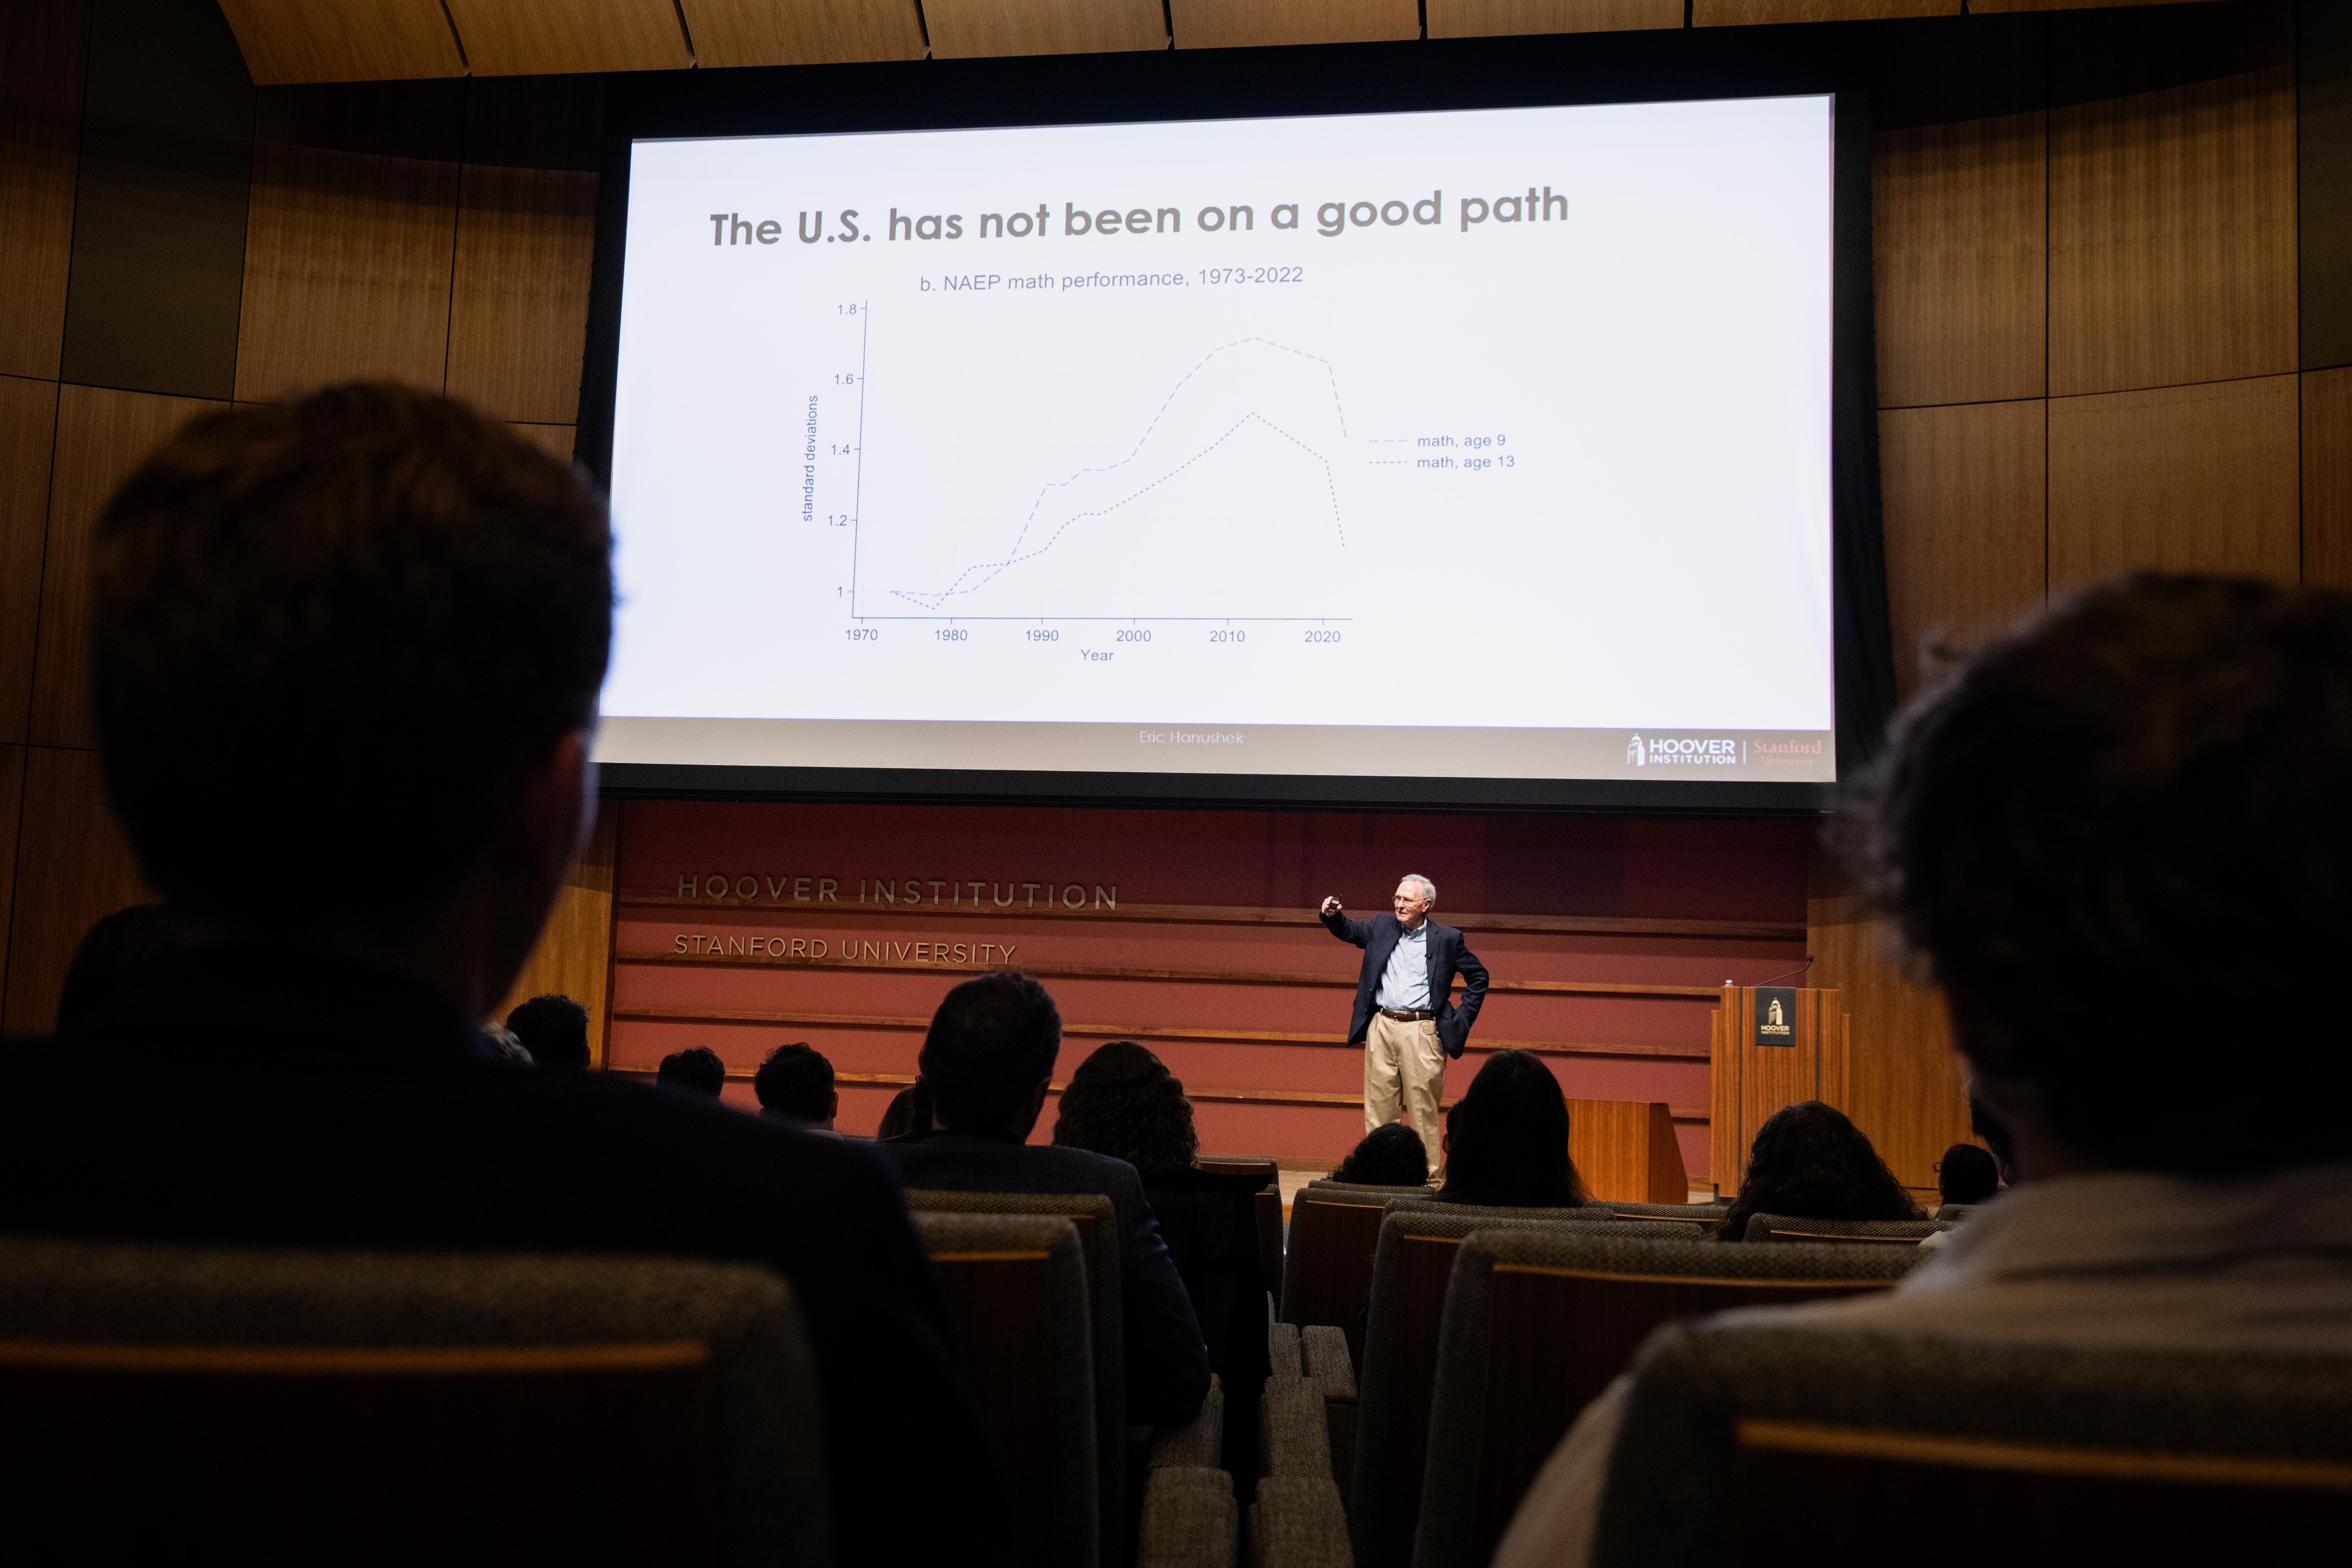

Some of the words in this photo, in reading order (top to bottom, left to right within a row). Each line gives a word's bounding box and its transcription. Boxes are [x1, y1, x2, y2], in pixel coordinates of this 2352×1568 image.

[710, 212, 782, 246] The
[799, 209, 871, 244] U.S.
[889, 207, 963, 241] has
[980, 203, 1051, 238] not
[1065, 202, 1181, 236] been
[1197, 205, 1254, 232] on
[1271, 204, 1299, 230] a
[1317, 189, 1442, 237] good
[1461, 186, 1568, 232] path
[920, 276, 936, 292] b.
[944, 274, 1001, 291] NAEP
[1008, 273, 1054, 289] math
[1062, 271, 1190, 292] performance,
[1199, 266, 1303, 285] 1973-2022
[838, 303, 857, 315] 1.8
[834, 373, 854, 385] 1.6
[804, 395, 818, 461] deviations
[1418, 435, 1458, 448] math,
[1464, 437, 1492, 449] age
[1497, 434, 1506, 446] 9
[831, 444, 850, 455] 1.4
[1417, 456, 1458, 469] math,
[1464, 458, 1491, 471] age
[1498, 455, 1515, 467] 13
[802, 465, 815, 522] standard
[828, 514, 847, 526] 1.2
[837, 586, 842, 597] 1
[846, 629, 878, 641] 1970
[935, 629, 968, 641] 1980
[1025, 629, 1059, 641] 1990
[1116, 630, 1152, 642] 2000
[1209, 630, 1246, 642] 2010
[1304, 630, 1341, 643] 2020
[1080, 649, 1114, 661] Year
[1139, 731, 1165, 743] Eric
[1170, 731, 1244, 744] Hanushek
[1649, 739, 1735, 754] HOOVER
[1754, 739, 1821, 754] Stanford
[1649, 755, 1736, 764] INSTITUTION
[677, 874, 840, 902] HOOVER
[859, 879, 1118, 910] INSTITUTION
[674, 934, 828, 959] STANFORD
[841, 939, 1017, 965] UNIVERSITY
